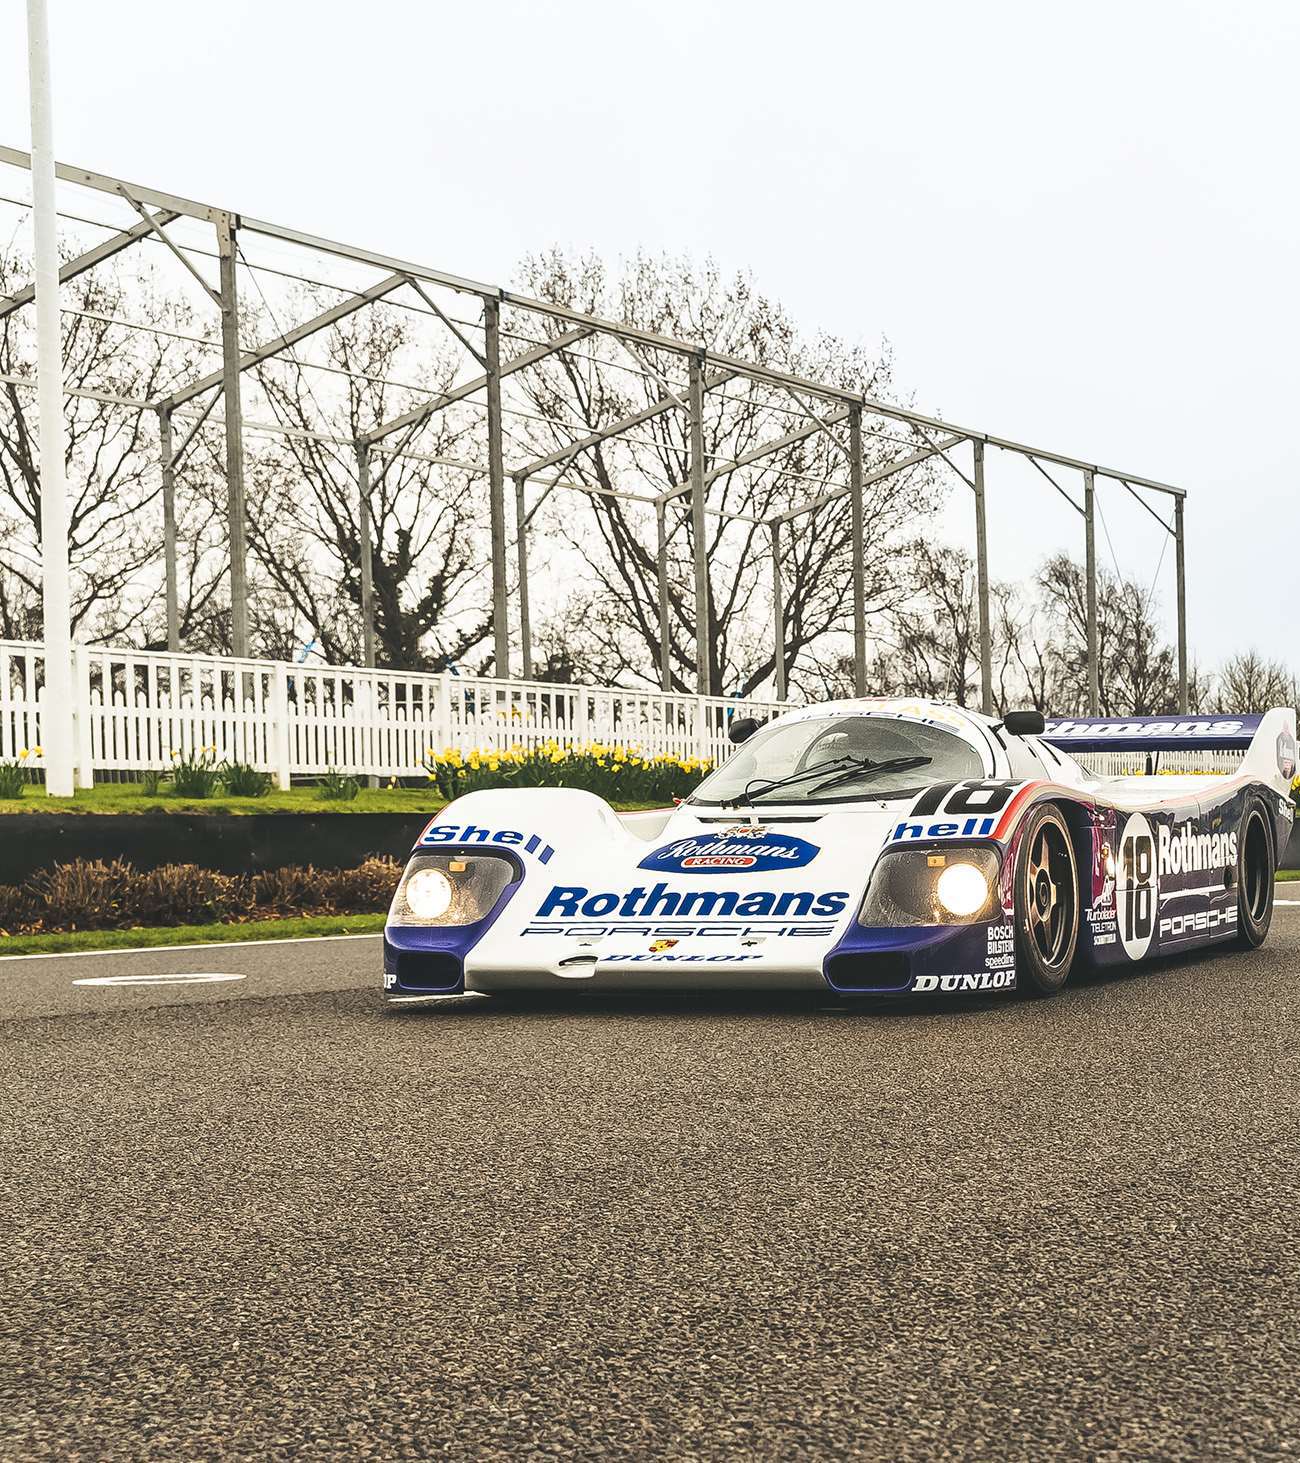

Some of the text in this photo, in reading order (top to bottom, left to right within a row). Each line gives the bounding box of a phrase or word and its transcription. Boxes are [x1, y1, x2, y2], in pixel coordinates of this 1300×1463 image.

[909, 780, 1024, 817] 18
[884, 818, 995, 844] hell
[424, 826, 555, 865] Shell
[657, 839, 800, 860] Rothmans
[1158, 821, 1238, 876] Rothmans
[692, 857, 746, 866] RACING
[535, 883, 850, 918] Rothmans
[1123, 835, 1152, 942] 18
[520, 925, 835, 937] PORSCHE
[987, 925, 1014, 940] BOSCH
[1159, 905, 1238, 938] PORSCHE
[599, 955, 765, 963] DUNLOP
[987, 940, 1014, 954] BILSTEIN
[911, 970, 1016, 992] DUNLOP
